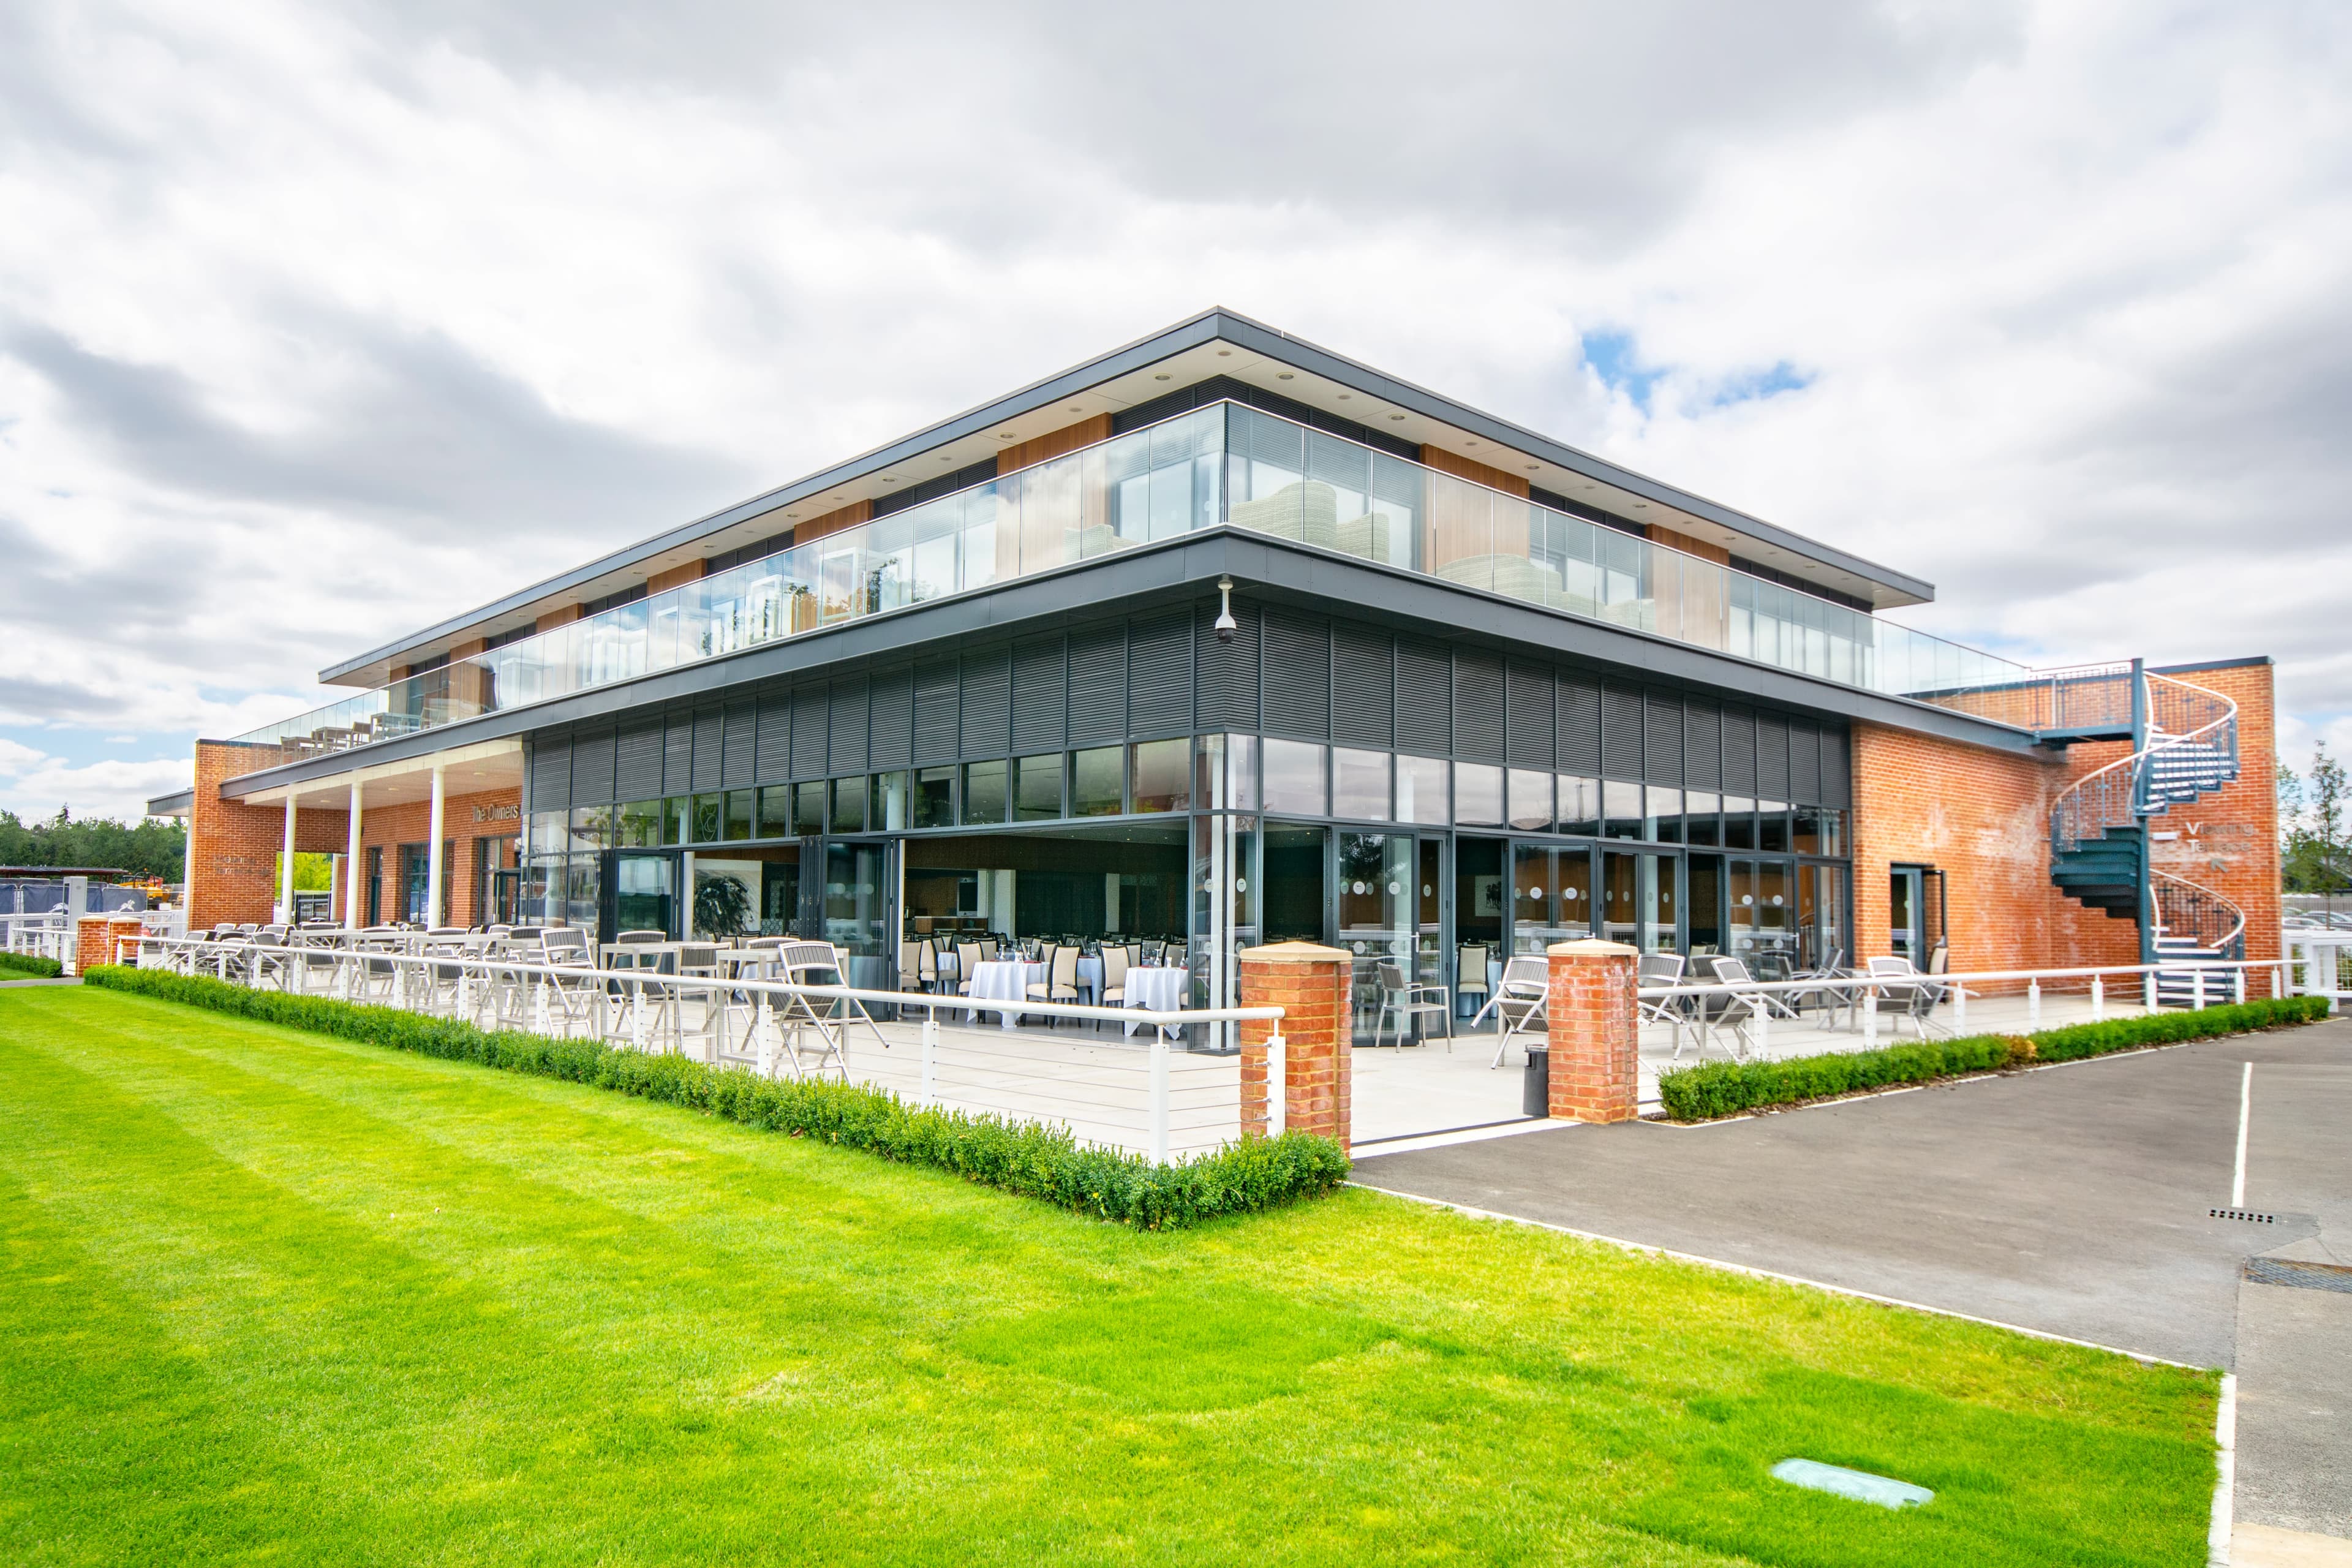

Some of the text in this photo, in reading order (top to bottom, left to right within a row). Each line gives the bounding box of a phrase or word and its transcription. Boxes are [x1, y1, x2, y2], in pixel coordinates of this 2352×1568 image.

[473, 803, 518, 823] The Owners
[2185, 821, 2254, 837] Viewing
[2186, 839, 2252, 853] Terrace
